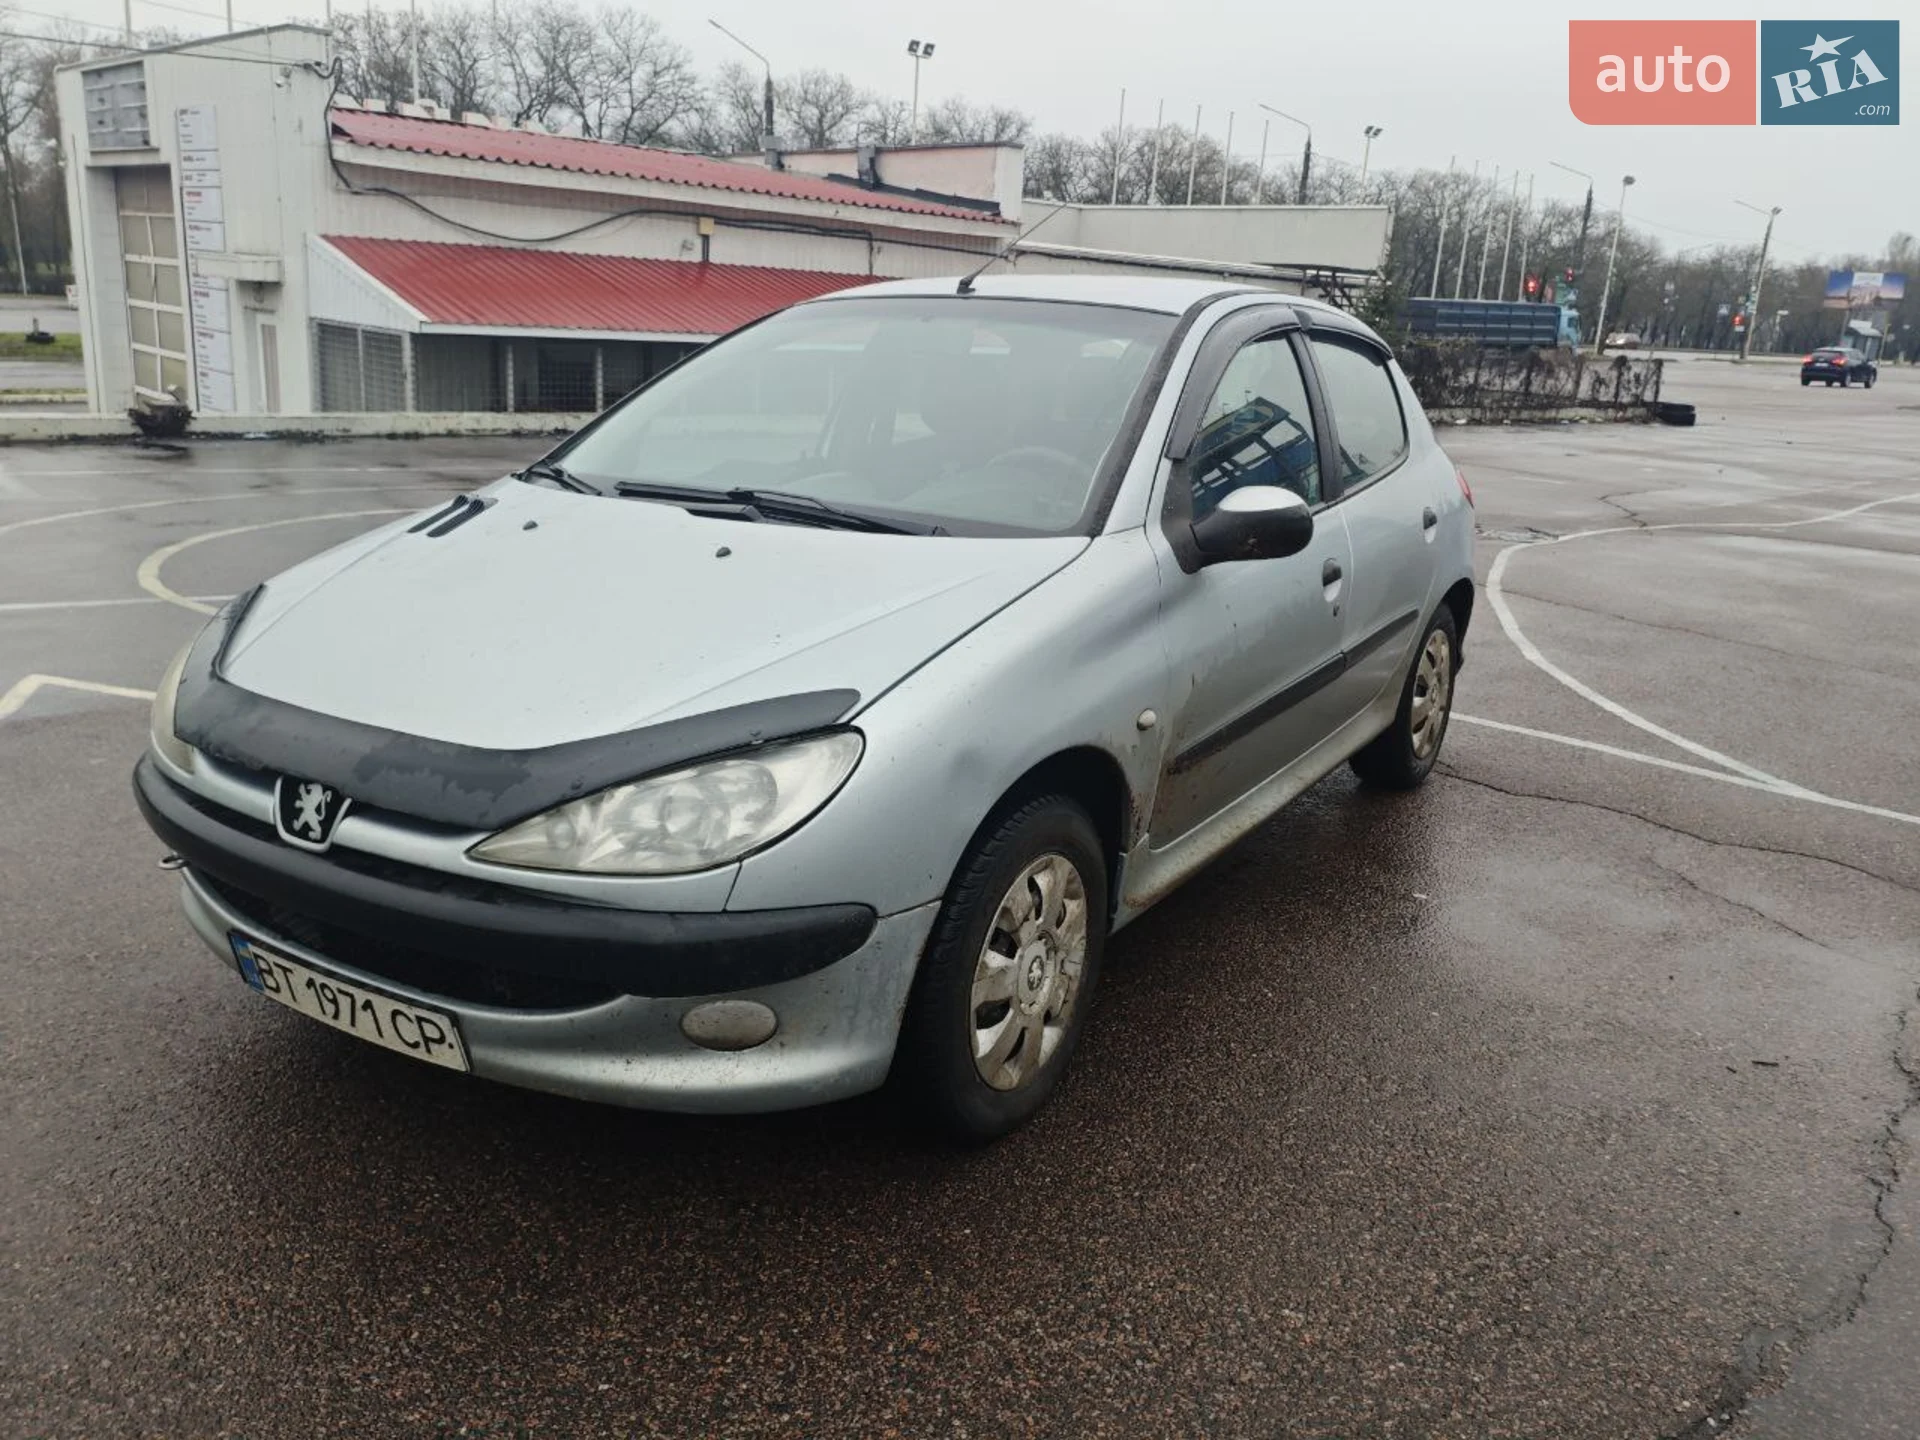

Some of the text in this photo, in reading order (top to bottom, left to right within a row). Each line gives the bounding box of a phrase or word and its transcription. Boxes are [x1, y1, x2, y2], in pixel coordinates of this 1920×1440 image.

[252, 951, 446, 1055] BT 1971 CP
